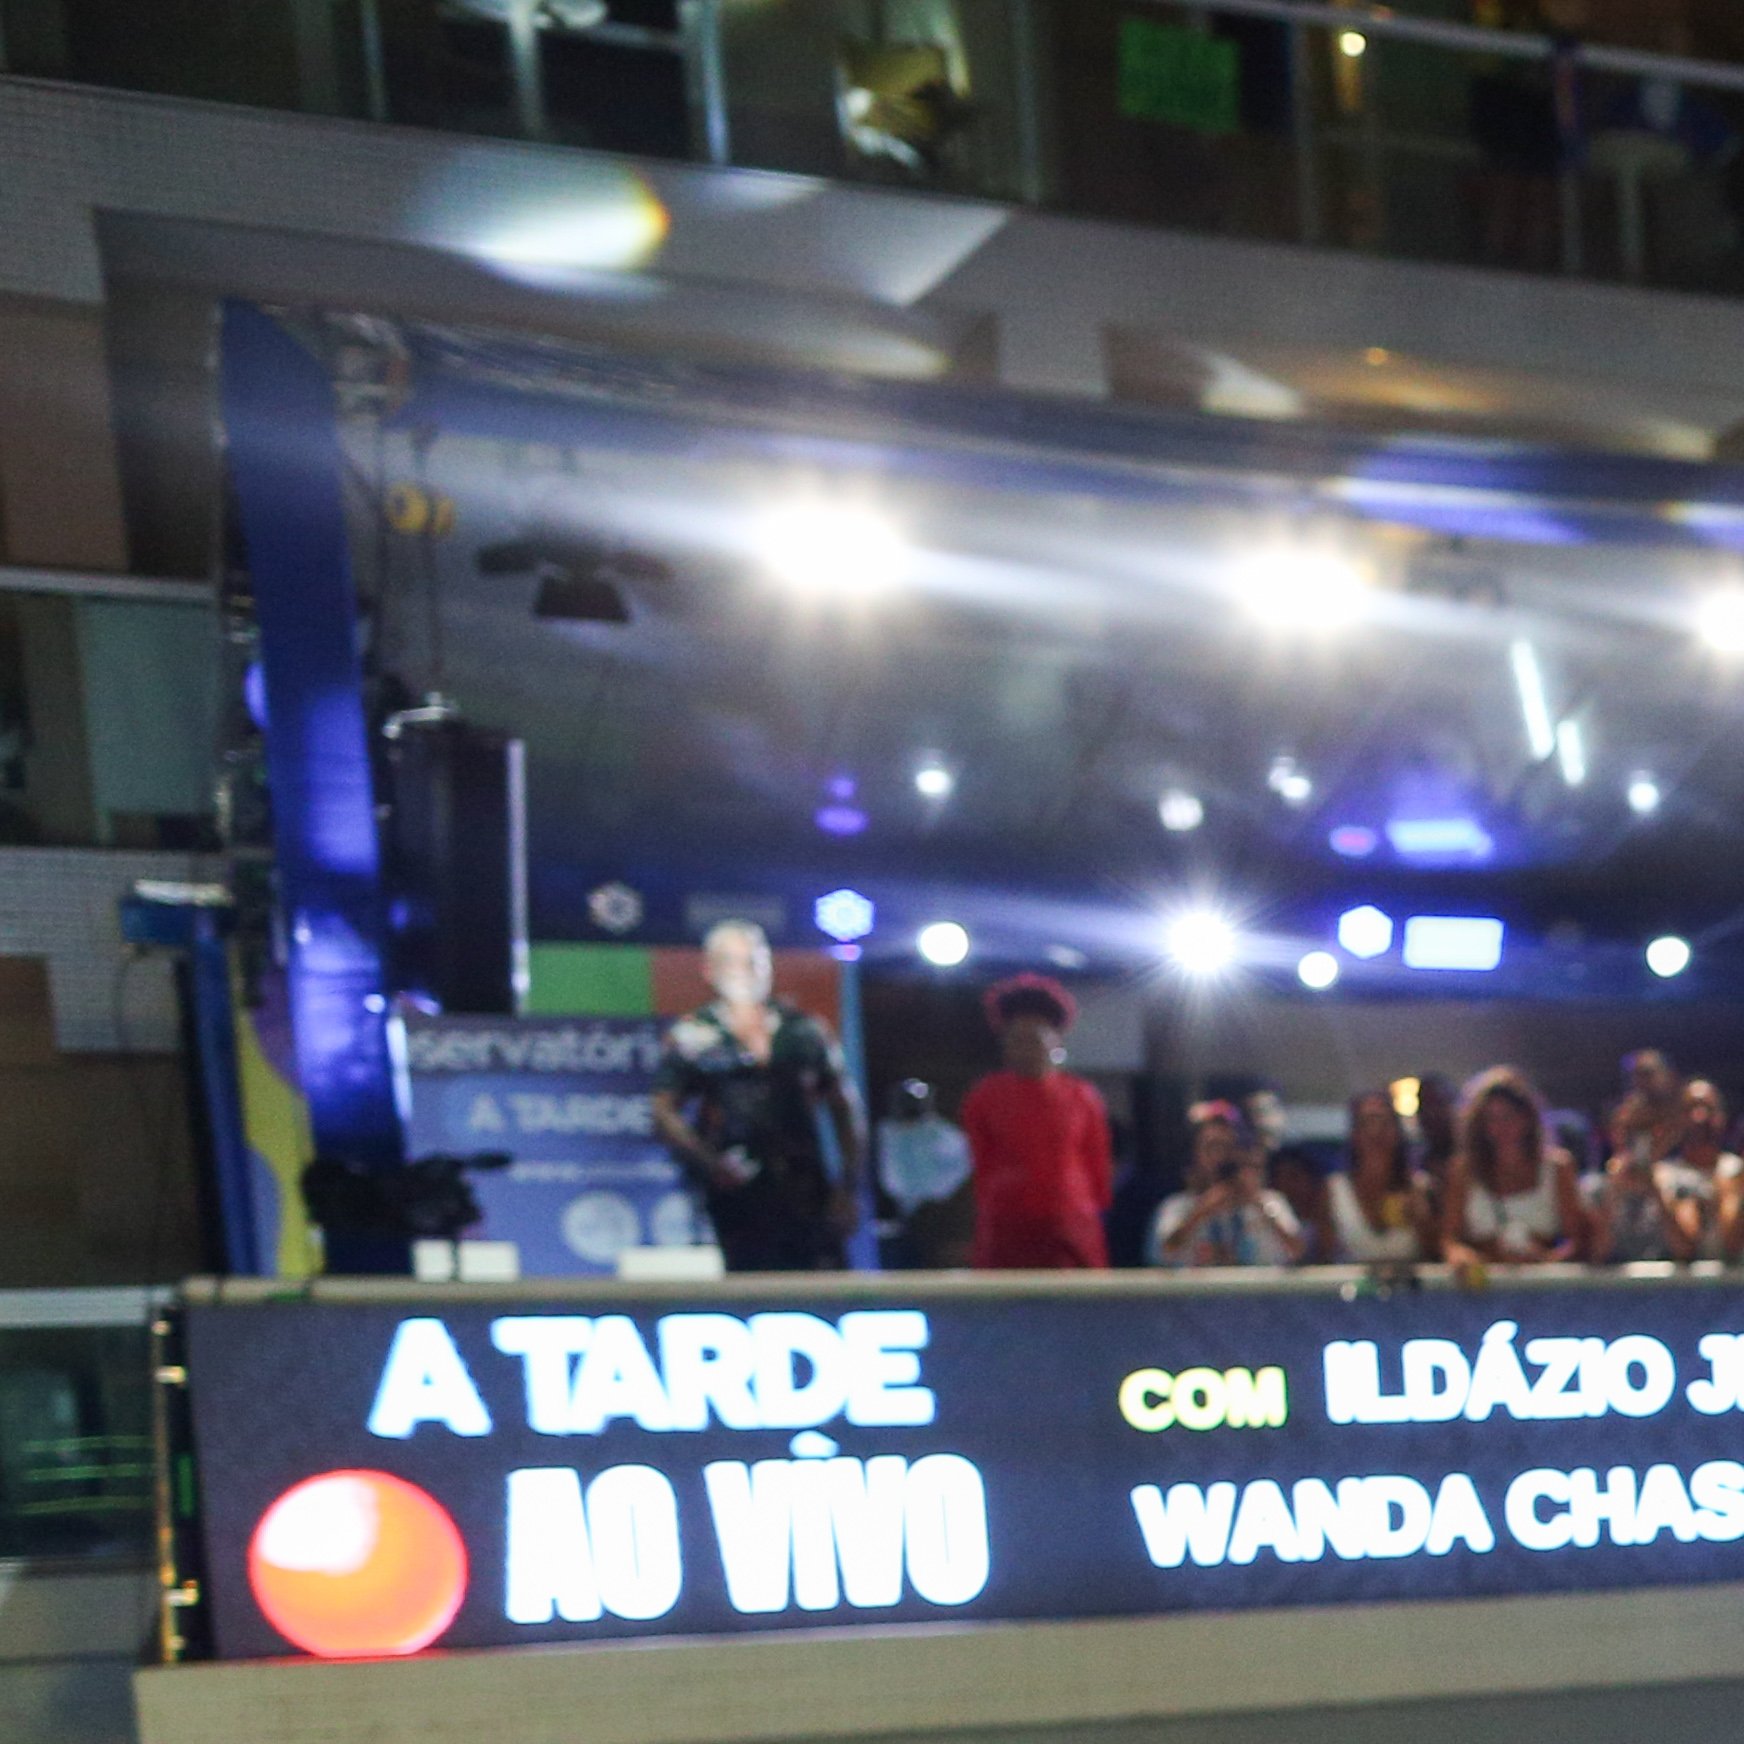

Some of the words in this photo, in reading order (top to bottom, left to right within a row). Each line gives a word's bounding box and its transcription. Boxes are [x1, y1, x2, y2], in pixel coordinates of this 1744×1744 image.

[367, 1317, 493, 1439] A
[491, 1309, 937, 1437] TARDE
[1117, 1366, 1290, 1432] COM
[1322, 1320, 1676, 1424] ILDÁZIO
[504, 1463, 684, 1623] AO
[1130, 1473, 1496, 1569] WANDA
